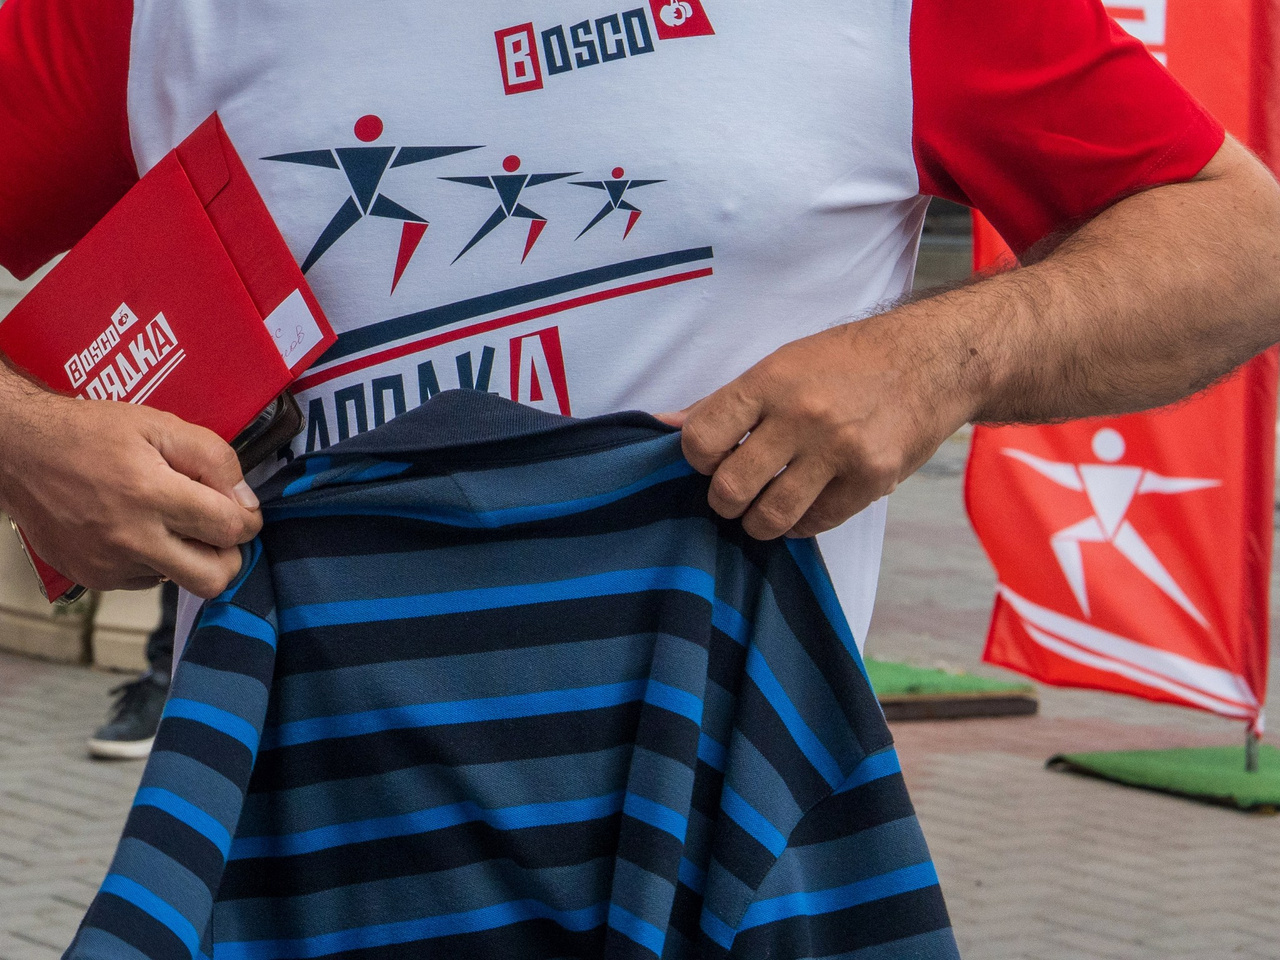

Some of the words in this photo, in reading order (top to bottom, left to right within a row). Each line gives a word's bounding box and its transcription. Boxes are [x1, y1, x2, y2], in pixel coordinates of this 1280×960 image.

[494, 7, 655, 95] BOSCO
[64, 324, 121, 389] BOSCO
[75, 311, 179, 402] РЯДКА
